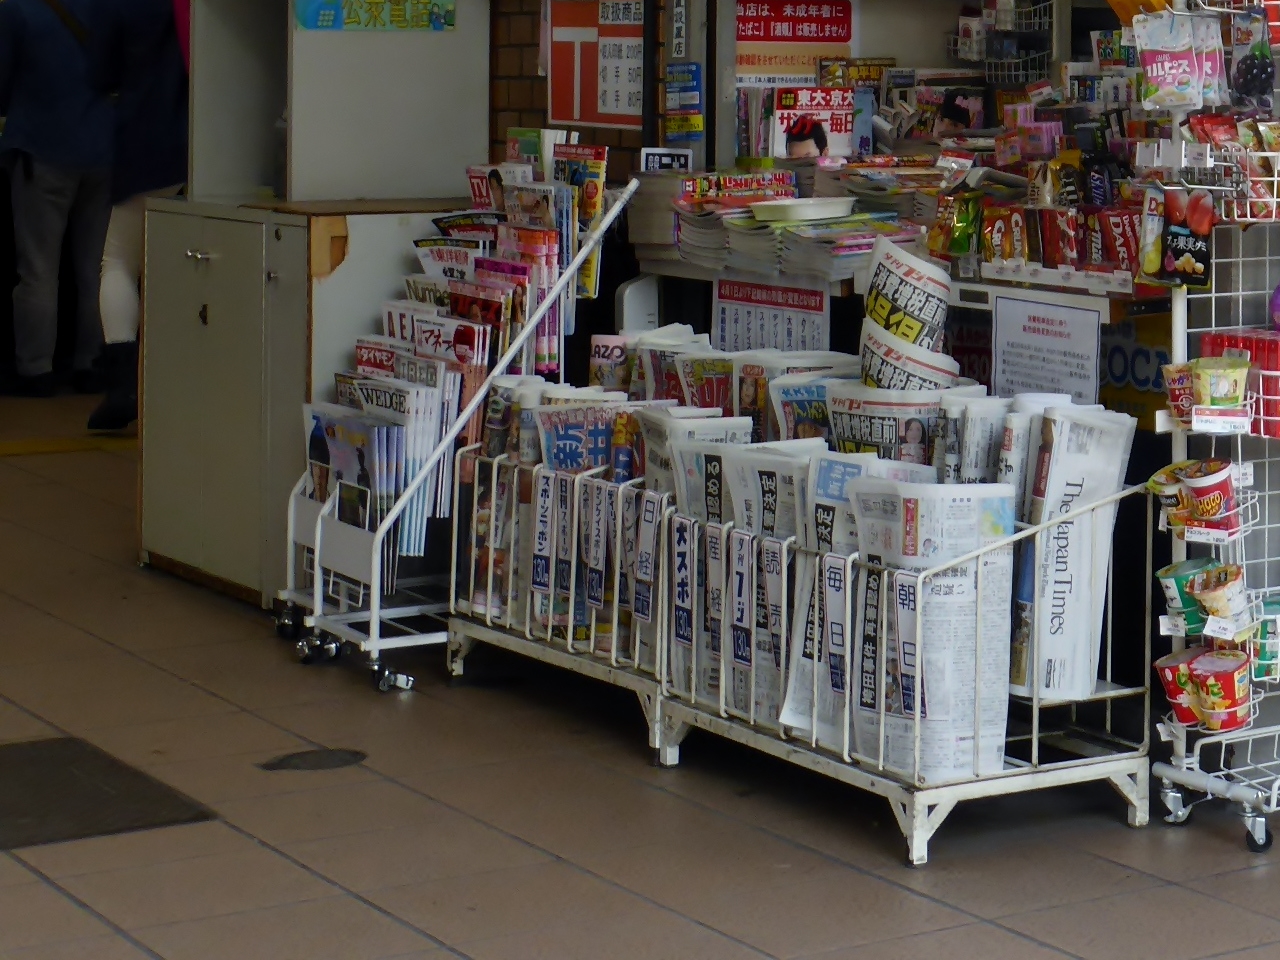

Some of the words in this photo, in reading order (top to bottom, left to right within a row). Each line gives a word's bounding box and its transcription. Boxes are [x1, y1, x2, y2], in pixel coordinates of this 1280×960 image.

[600, 1, 643, 23] 取扱商品
[1109, 216, 1131, 271] DARS
[406, 278, 451, 307] Numbe
[358, 386, 407, 414] WEDGE
[1061, 477, 1085, 517] The
[676, 522, 690, 604] 大スポ
[826, 563, 845, 648] 毎日
[897, 582, 918, 668] 朝日
[1049, 574, 1074, 636] Times
